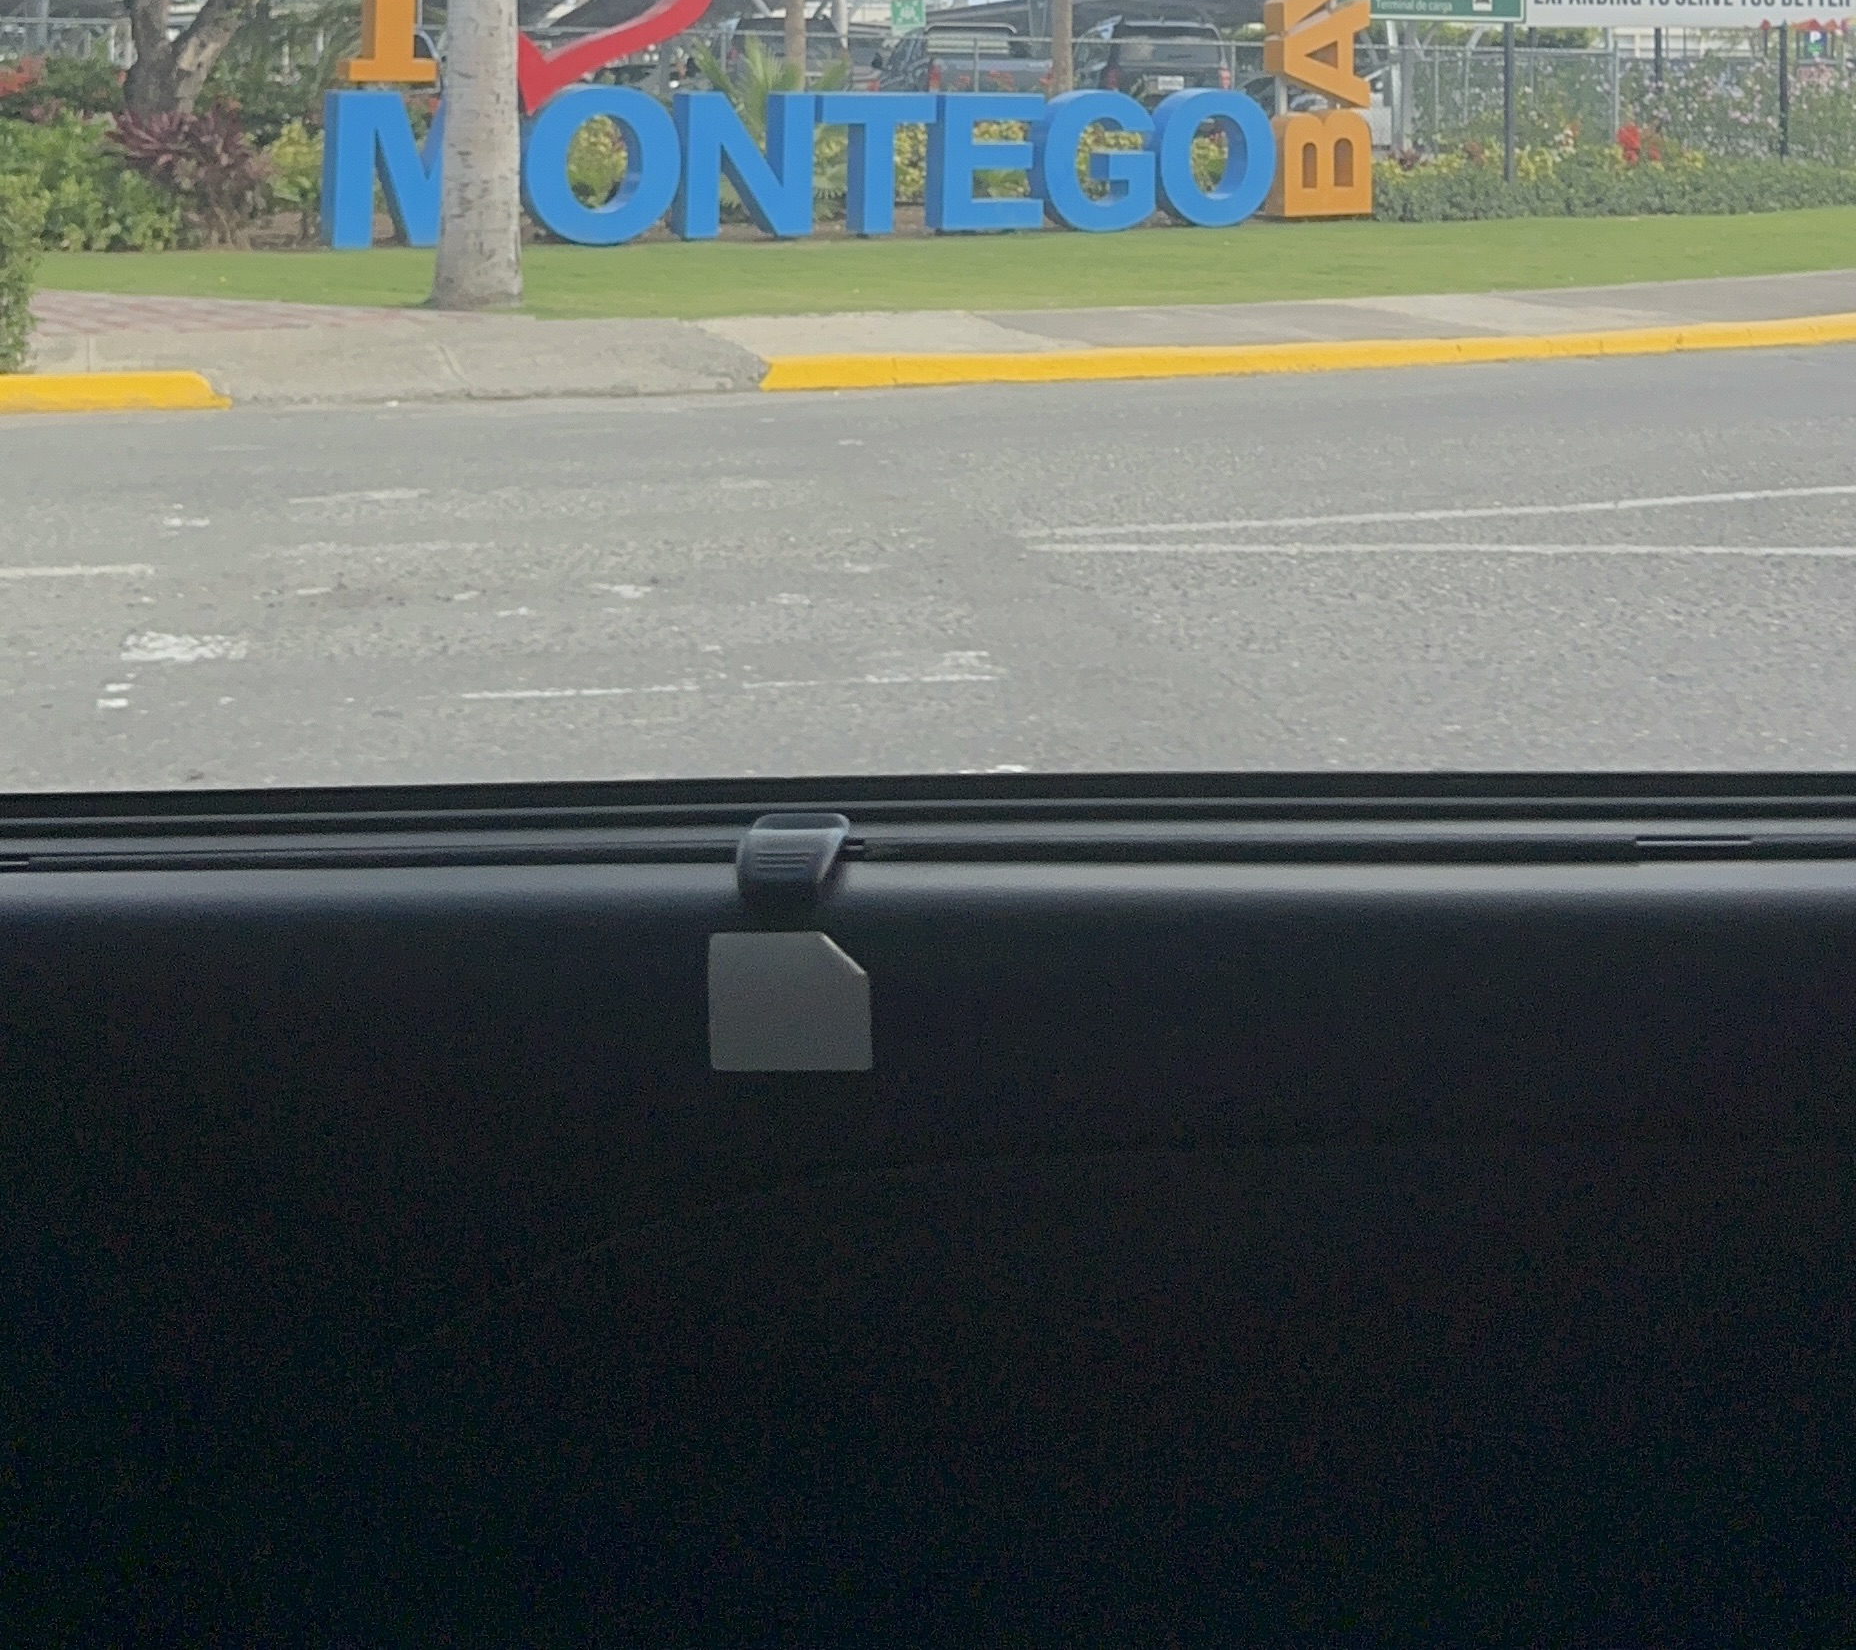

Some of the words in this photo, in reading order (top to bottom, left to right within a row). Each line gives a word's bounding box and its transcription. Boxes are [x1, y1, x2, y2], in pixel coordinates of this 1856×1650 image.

[1415, 0, 1427, 11] de
[1428, 2, 1453, 14] carga
[325, 87, 1276, 248] MONTEGO
